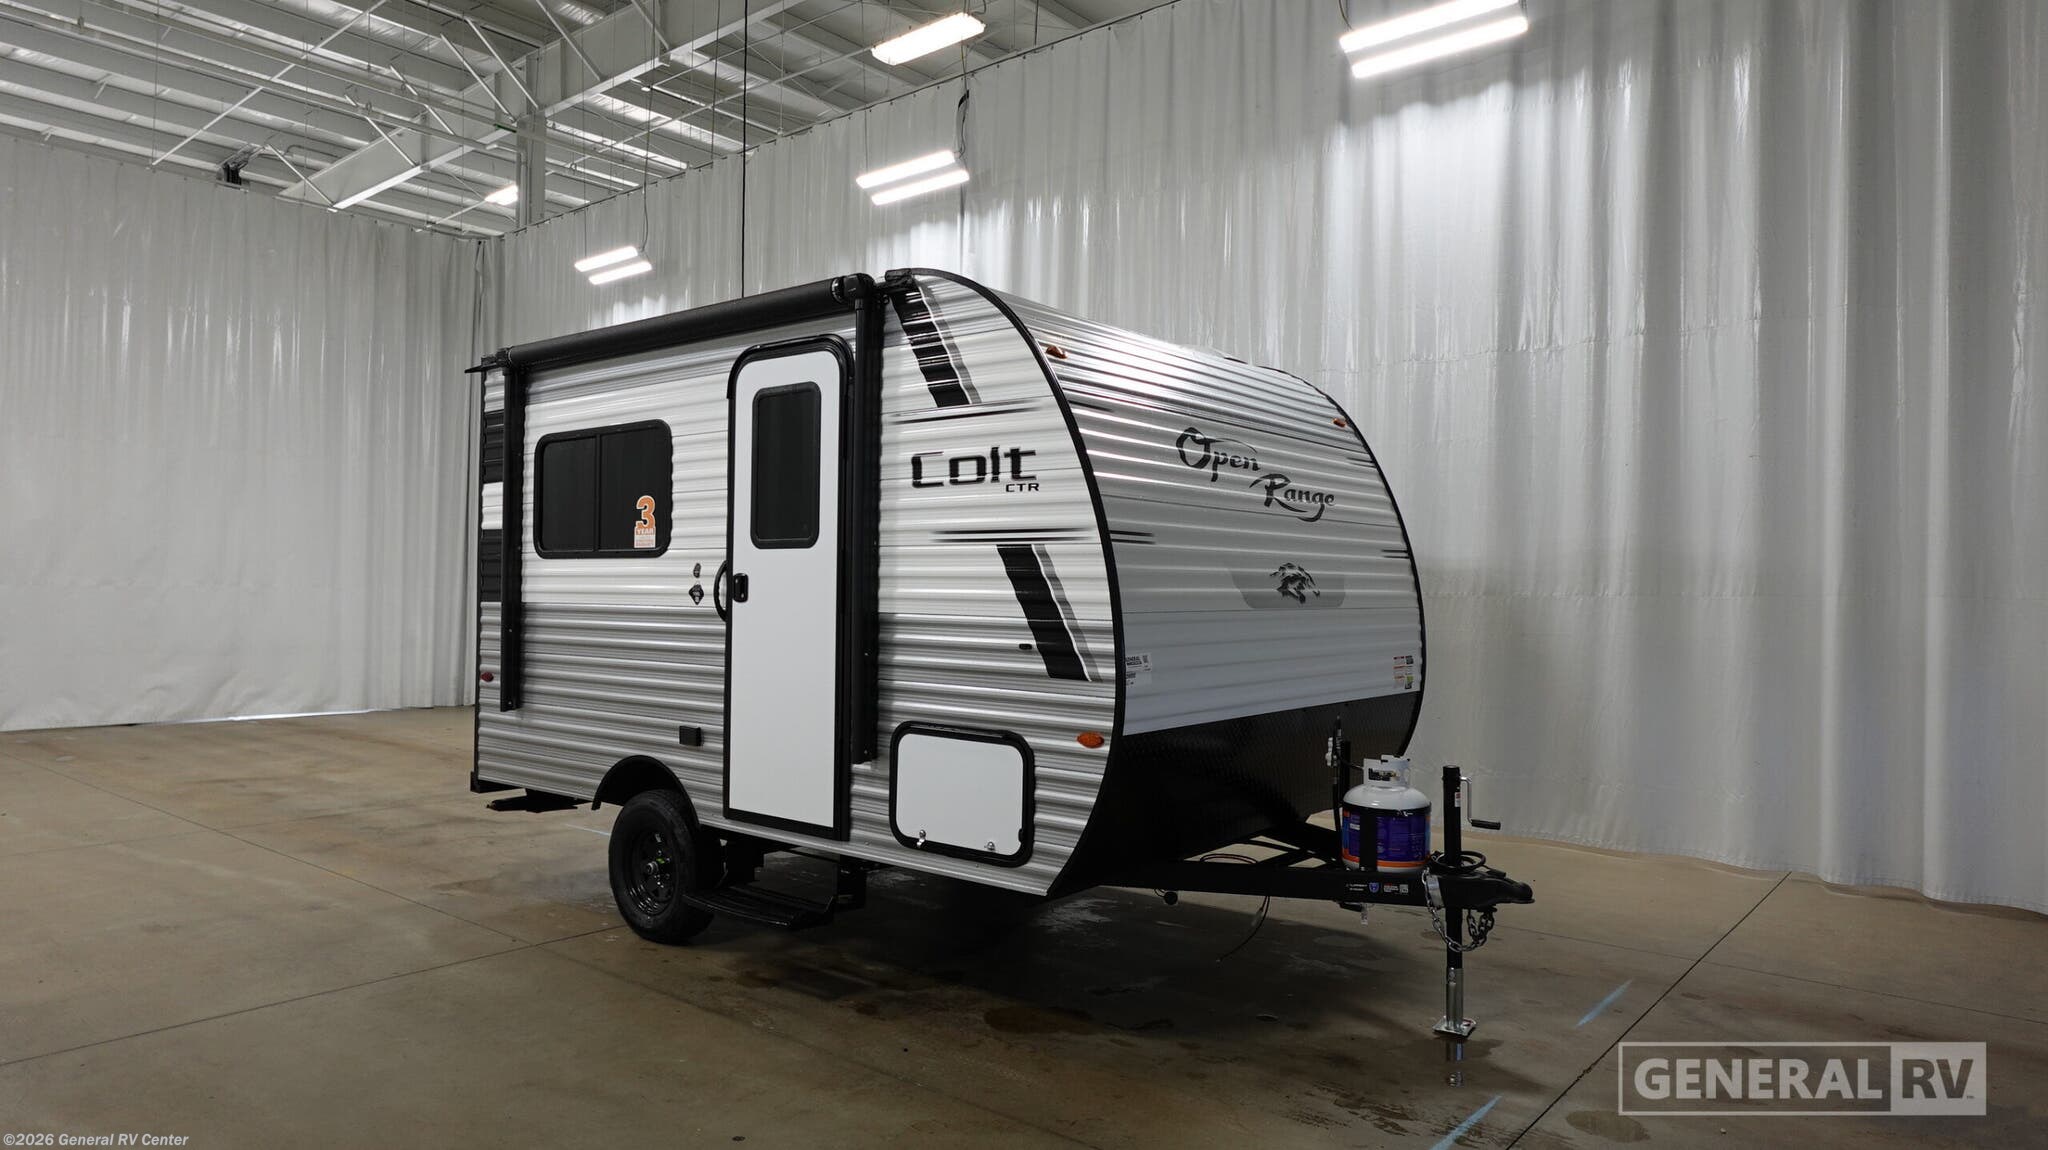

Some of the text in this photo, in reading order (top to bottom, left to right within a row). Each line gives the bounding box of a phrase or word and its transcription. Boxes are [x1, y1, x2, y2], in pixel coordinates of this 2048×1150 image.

[911, 446, 1036, 488] Colt
[1176, 427, 1261, 482] Open
[1006, 483, 1039, 492] CTR
[1249, 473, 1336, 522] Range
[636, 495, 655, 528] 3
